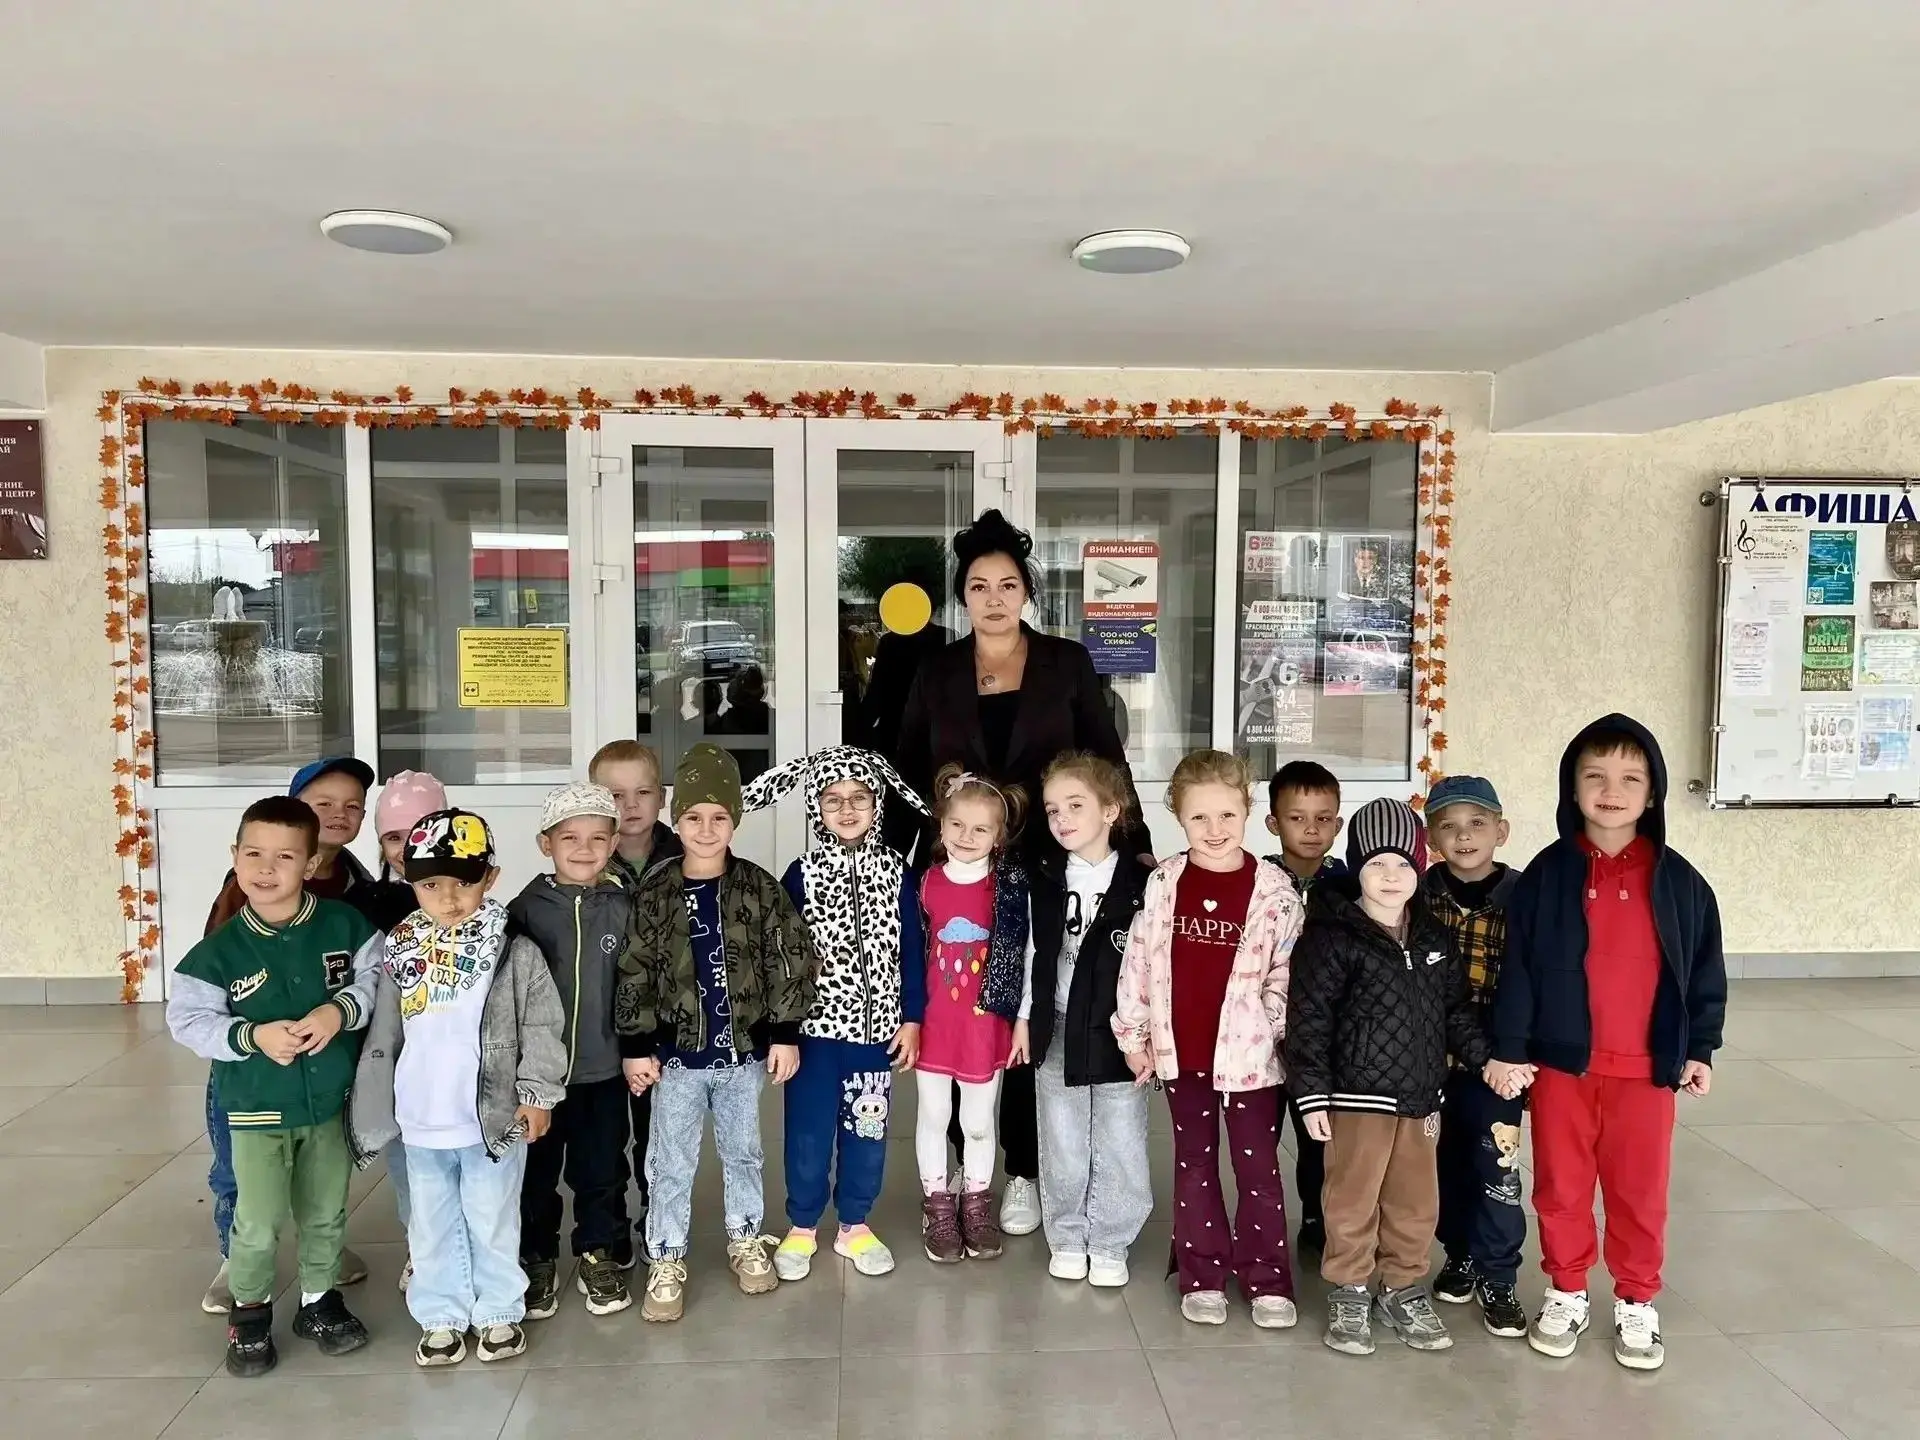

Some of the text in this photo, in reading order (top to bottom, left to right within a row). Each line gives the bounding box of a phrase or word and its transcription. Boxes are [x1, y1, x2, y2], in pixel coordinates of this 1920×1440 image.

[5, 490, 36, 498] ЦЕНТР
[1749, 492, 1918, 524] АФИША
[1089, 545, 1154, 554] ВНИМАНИЕ!!!
[1249, 535, 1260, 550] 6
[1808, 634, 1848, 646] DRIVE
[1279, 662, 1299, 685] 6
[1171, 916, 1246, 940] HAPPY
